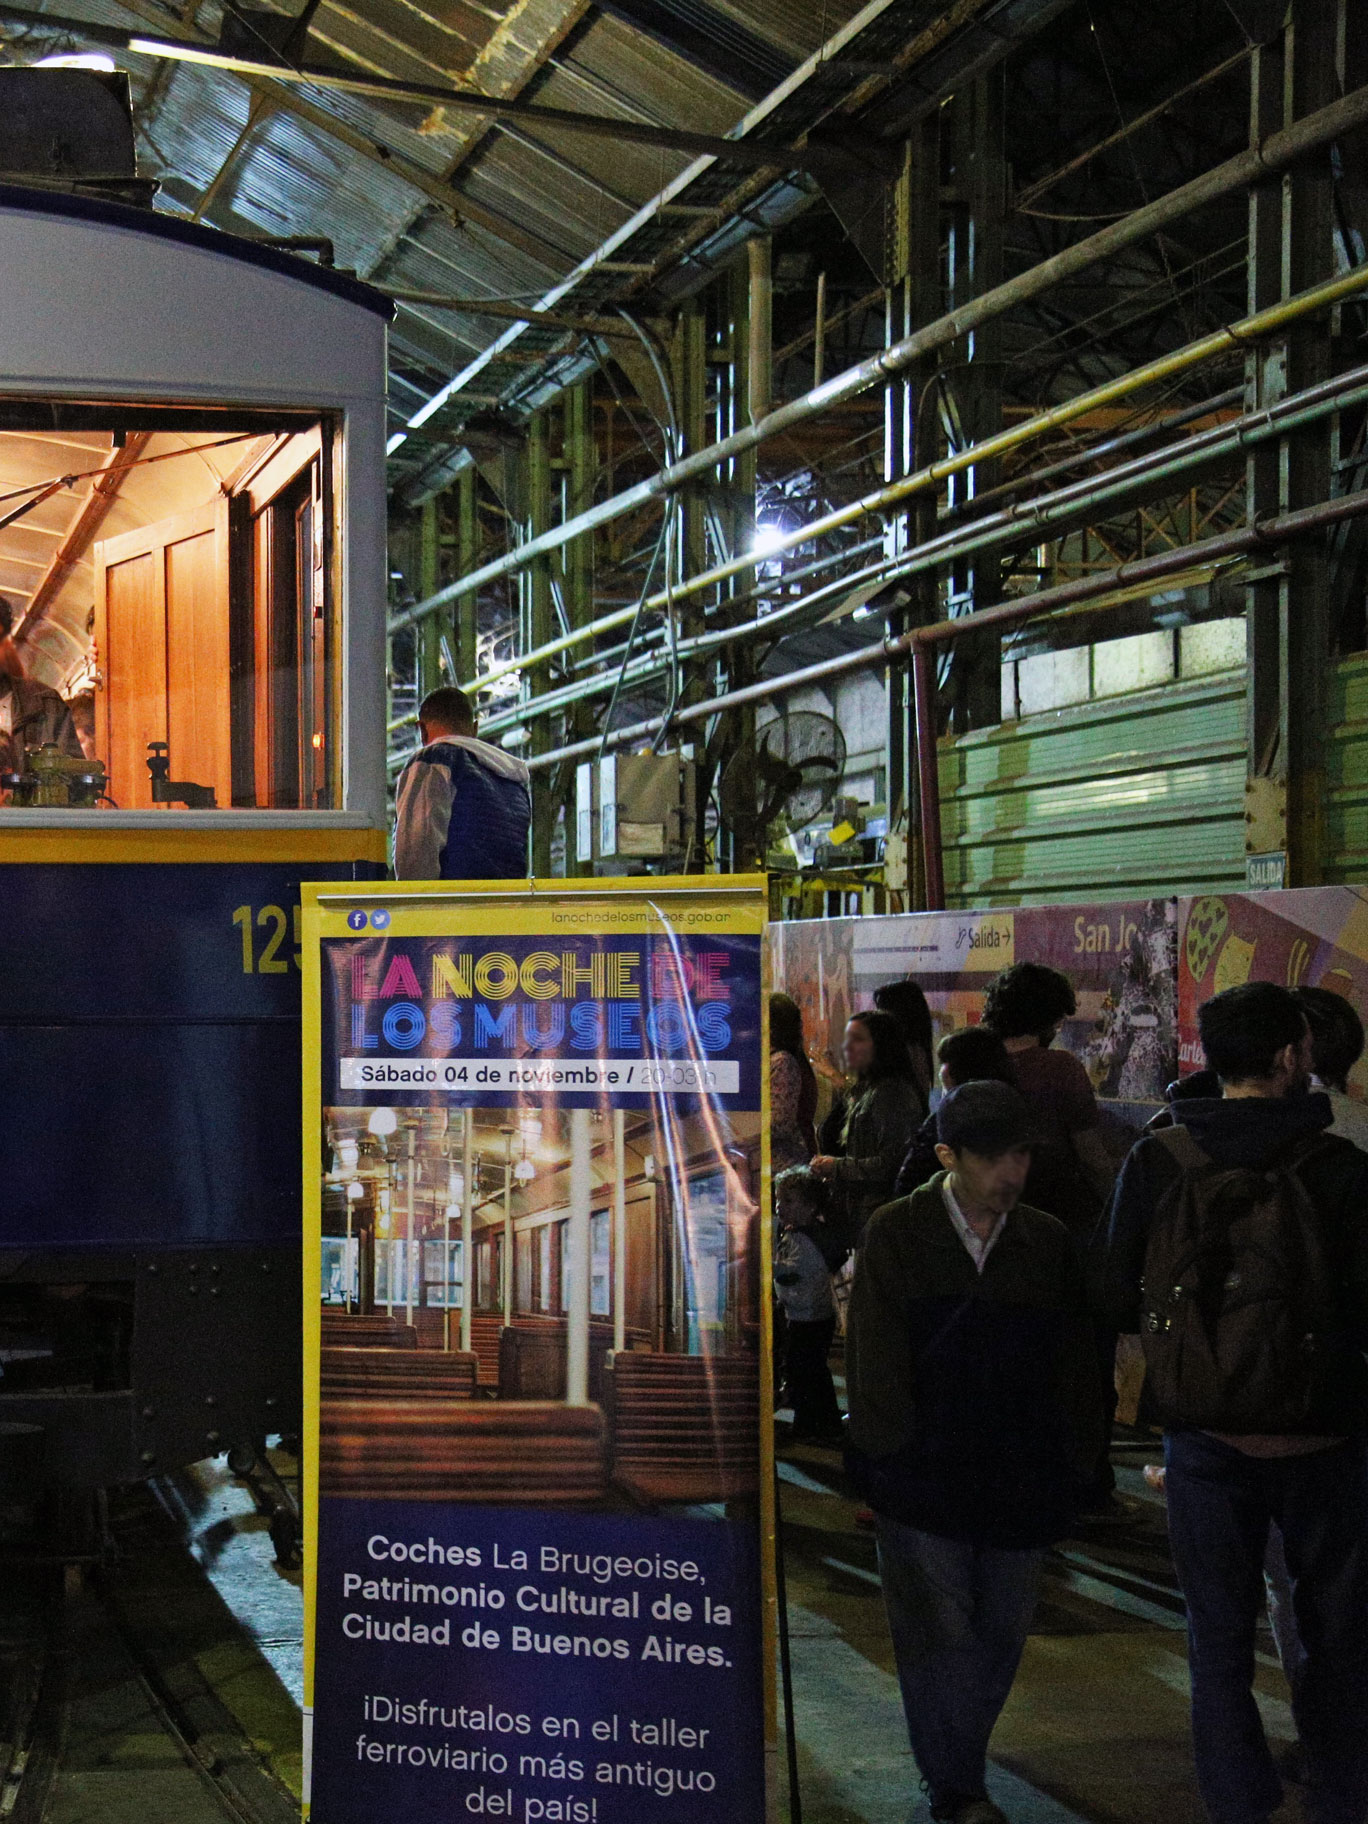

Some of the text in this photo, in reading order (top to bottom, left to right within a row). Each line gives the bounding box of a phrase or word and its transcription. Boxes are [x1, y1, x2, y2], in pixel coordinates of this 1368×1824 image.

[1249, 861, 1283, 885] SALIDA
[551, 911, 731, 924] lanochedelosmuseos.gob.ar
[1074, 915, 1110, 952] San
[968, 925, 1000, 949] Salida
[351, 951, 730, 1000] LA NOCHE DE
[351, 1002, 732, 1052] LOS MUSEOS
[361, 1064, 437, 1083] Sábado
[445, 1066, 469, 1083] 04
[476, 1066, 501, 1084] de
[509, 1065, 620, 1085] noviembre
[367, 1534, 706, 1585] Coches La Brugeoise,
[343, 1573, 732, 1625] Patrimonio Cultural de la
[342, 1612, 733, 1668] Ciudad de Buenos Aires.
[542, 1717, 580, 1739] en
[592, 1714, 618, 1742] el
[630, 1717, 710, 1749] taller
[356, 1734, 716, 1797] ferroviario más antiguo
[465, 1786, 598, 1824] del país!
